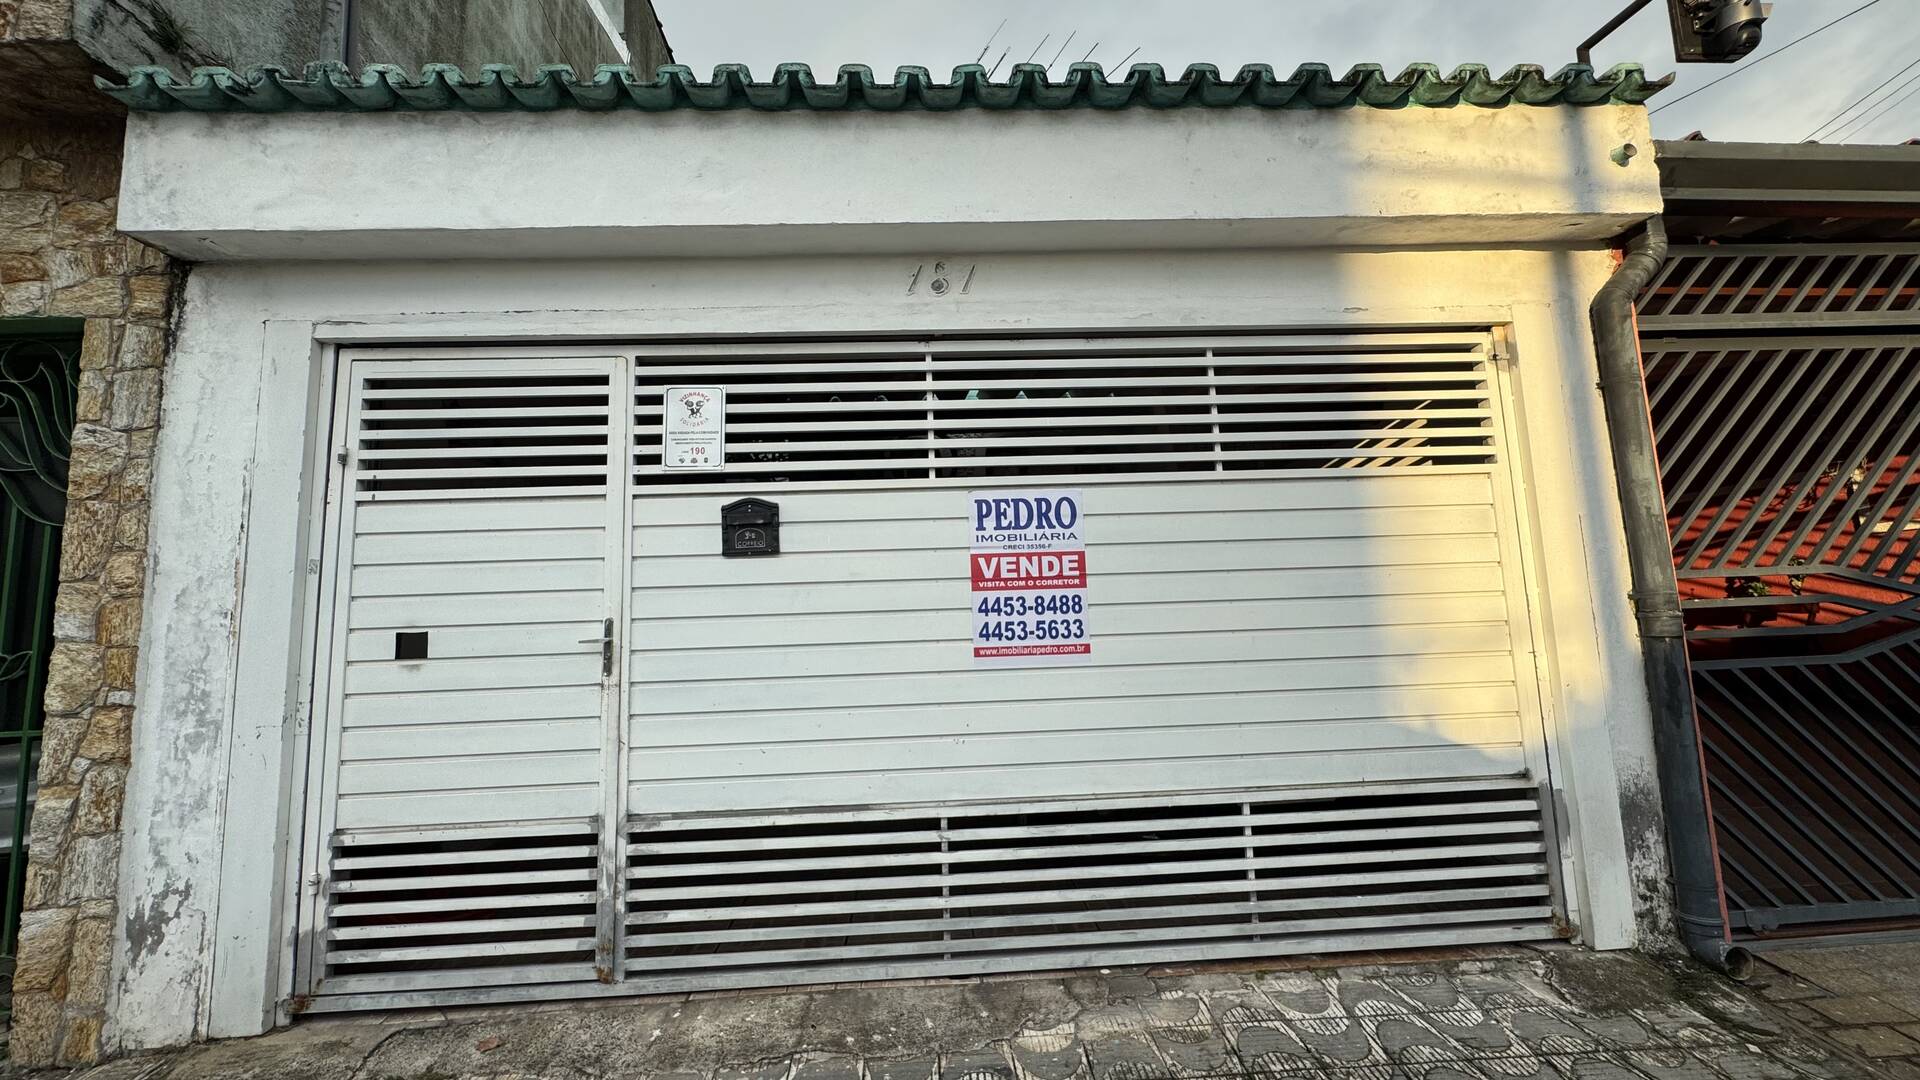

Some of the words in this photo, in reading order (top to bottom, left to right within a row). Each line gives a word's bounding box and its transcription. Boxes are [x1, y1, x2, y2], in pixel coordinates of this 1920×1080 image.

[905, 261, 977, 297] 181
[679, 391, 711, 403] VIZINHANÇA
[690, 447, 706, 455] 190
[974, 496, 1077, 531] PEDRO
[975, 531, 1078, 543] IMOBILIÁRIA
[977, 555, 1080, 579] VENDE
[978, 580, 1005, 588] VISITA
[978, 594, 1083, 617] 4453-8488
[978, 619, 1085, 641] 4453-5633
[979, 645, 1085, 656] www.imobiliariapedro.com.br
